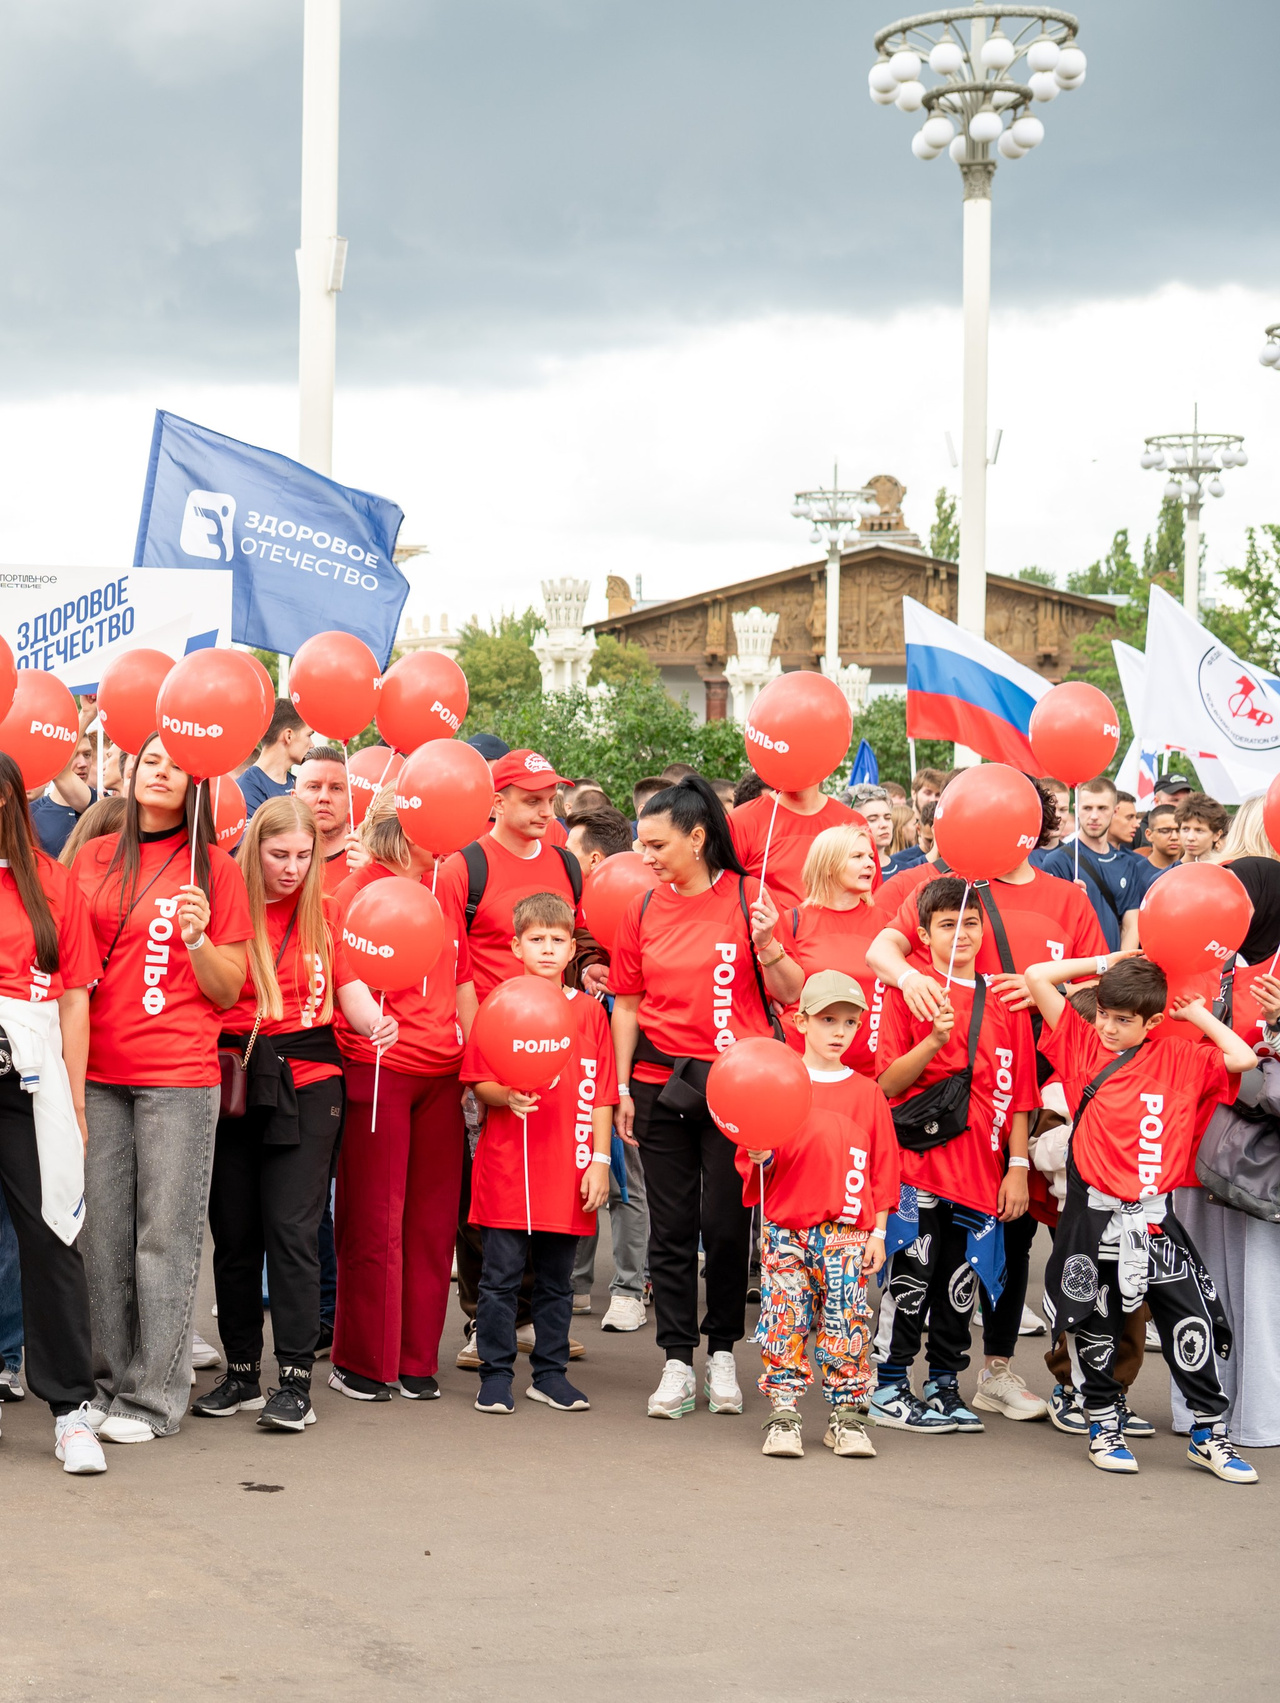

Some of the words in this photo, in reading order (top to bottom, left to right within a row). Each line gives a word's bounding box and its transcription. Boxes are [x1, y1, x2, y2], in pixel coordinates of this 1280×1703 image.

[240, 537, 379, 592] ОТЕЧЕСТВО
[244, 510, 380, 569] ЗДОРОВОЕ
[16, 607, 135, 673] ОТЕЧЕСТВО
[17, 576, 129, 652] ЗДОРОВОЕ
[30, 720, 79, 744] РОЛЬФ
[162, 714, 224, 739] РОЛЬФ
[348, 773, 383, 793] ОЛЬФ
[142, 898, 177, 1015] РОЛЬФ
[342, 928, 395, 959] РОЛЬФ
[713, 943, 737, 1053] РОЛЬФ
[867, 977, 885, 1053] ОЛЬФ
[513, 1036, 571, 1054] РОЛЬФ
[574, 1058, 597, 1170] РОЛЬФ
[991, 1047, 1013, 1152] РОЛЬФ
